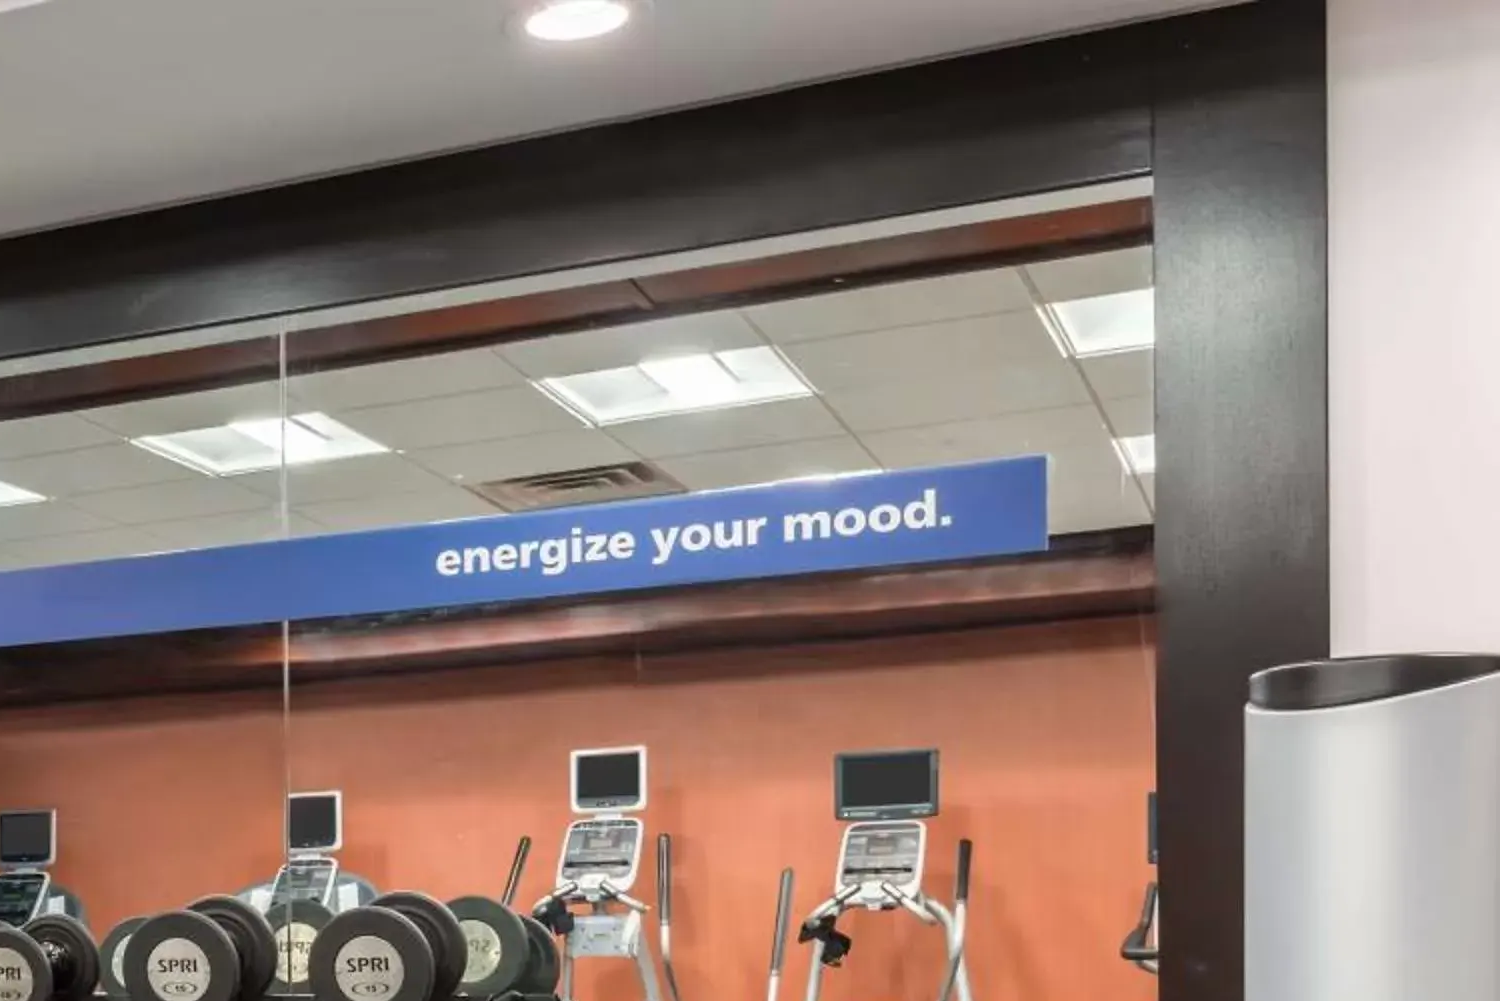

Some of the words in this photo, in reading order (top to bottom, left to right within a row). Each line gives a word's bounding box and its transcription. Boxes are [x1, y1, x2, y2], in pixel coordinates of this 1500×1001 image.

[434, 526, 636, 578] energize
[651, 514, 768, 566] your
[783, 488, 953, 543] mood.
[157, 957, 198, 973] SPRI
[346, 956, 390, 973] SPRI
